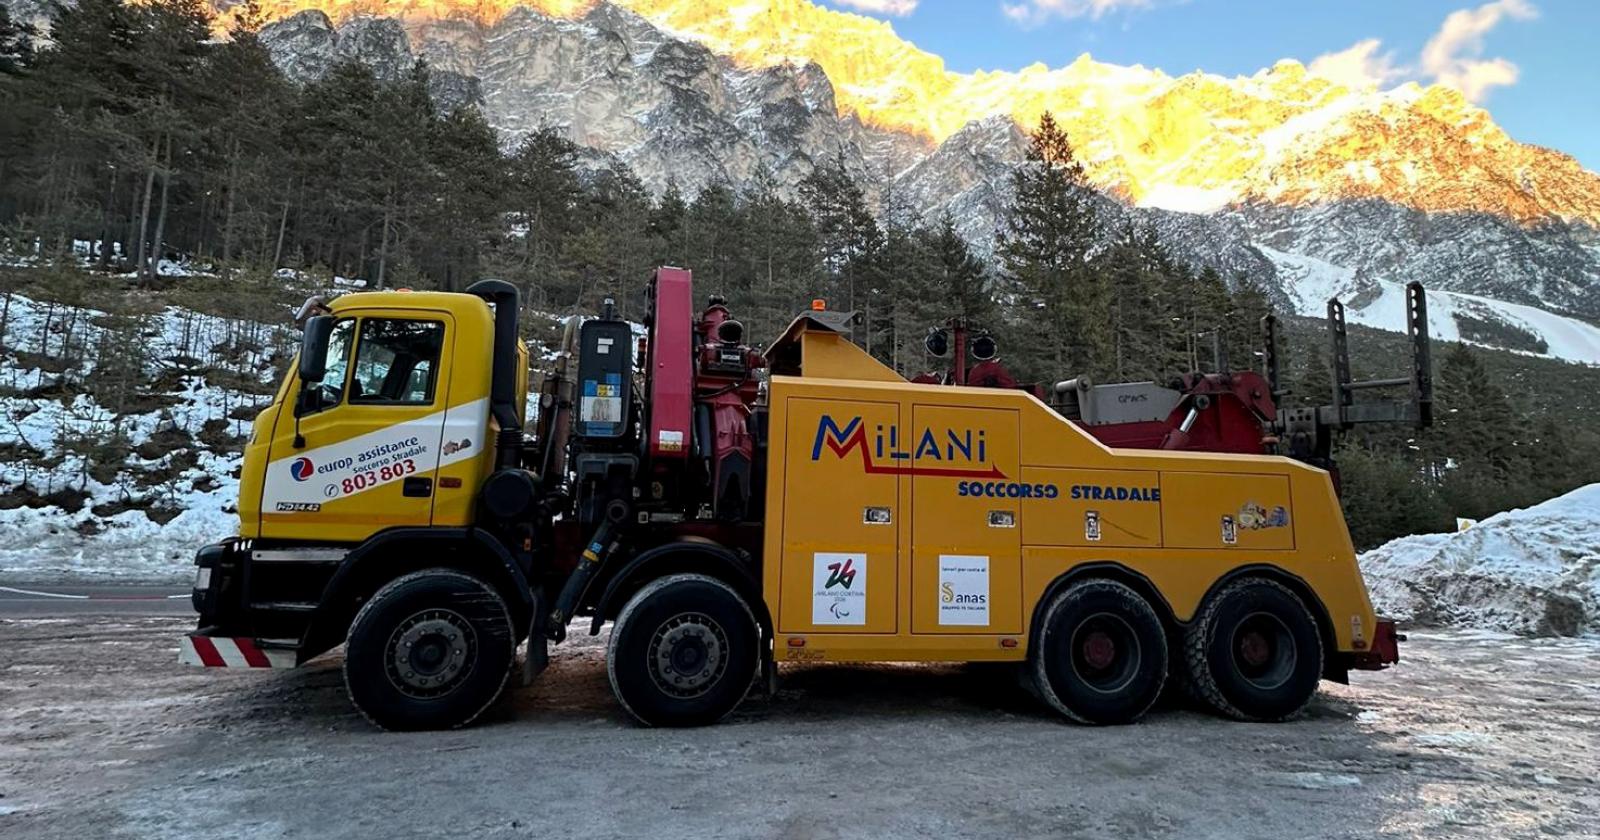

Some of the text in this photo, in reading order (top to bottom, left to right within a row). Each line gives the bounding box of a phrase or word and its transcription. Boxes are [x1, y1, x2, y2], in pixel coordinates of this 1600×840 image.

[317, 435, 419, 475] europ assistance
[392, 444, 428, 462] Stradale
[341, 458, 417, 495] 803 803
[957, 480, 1161, 502] SOCCORSO STRADALE
